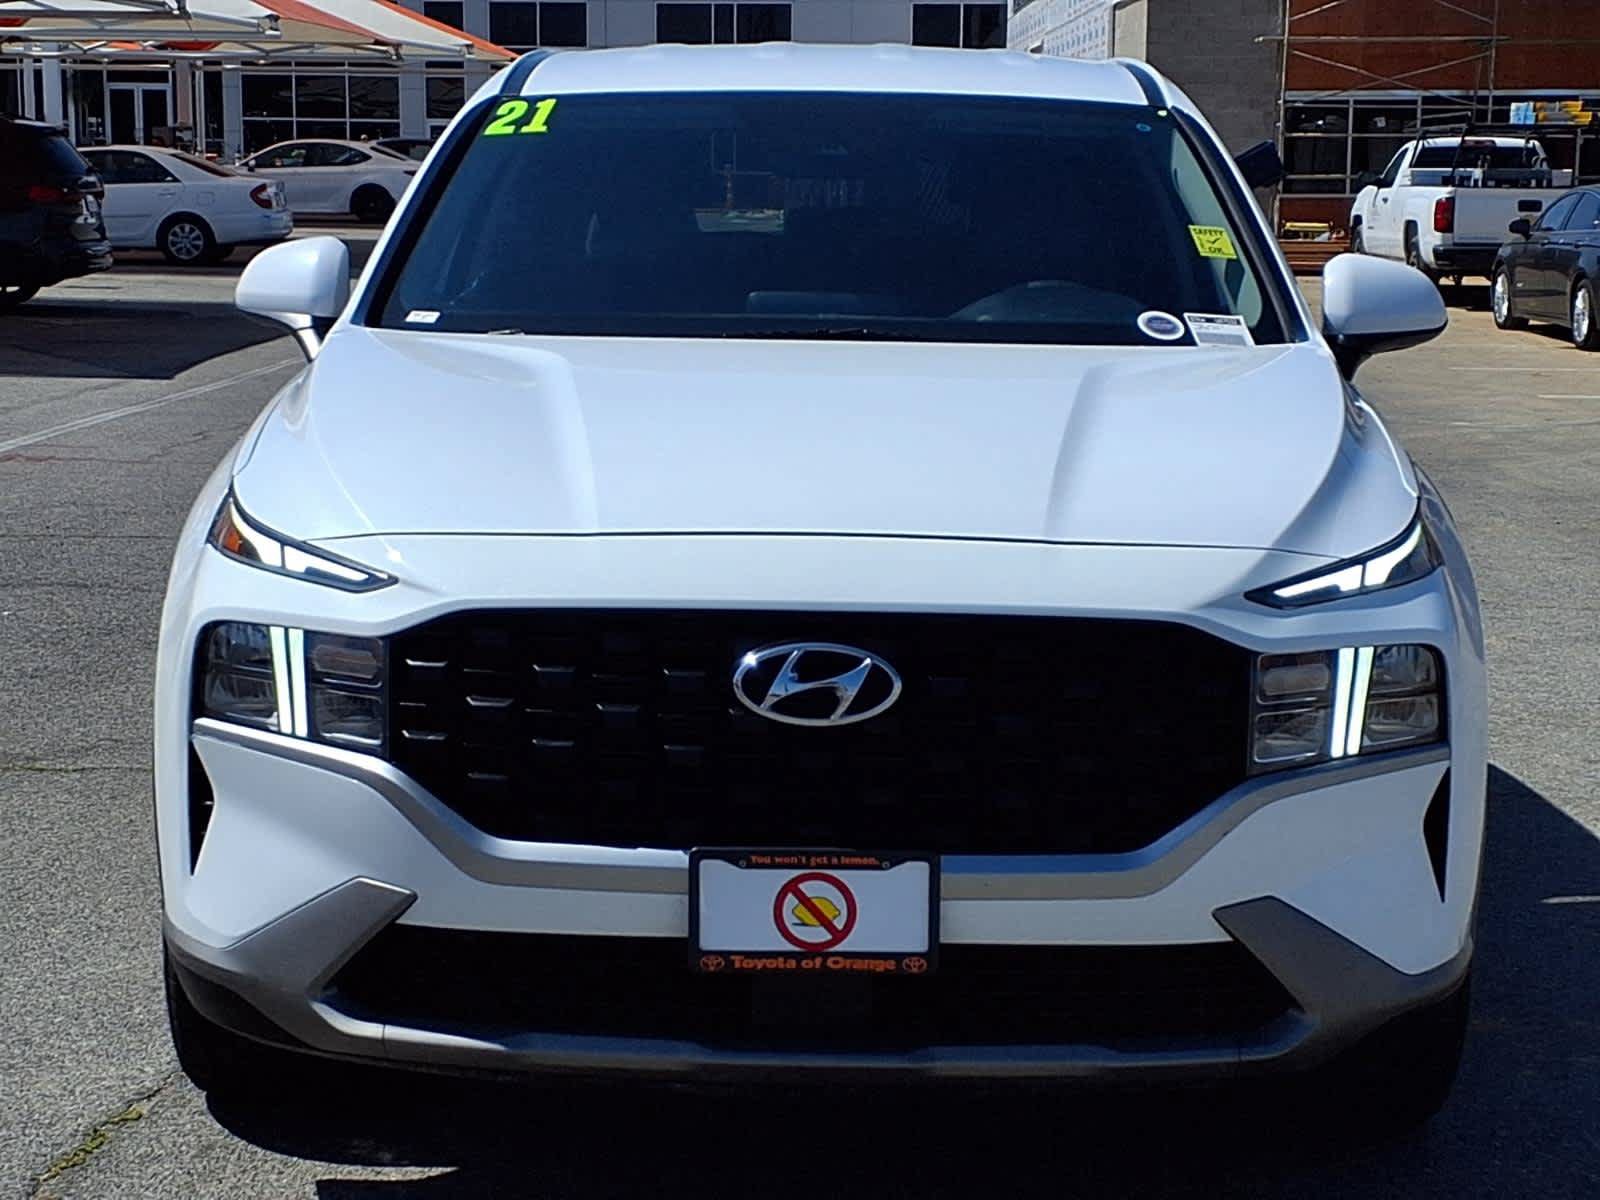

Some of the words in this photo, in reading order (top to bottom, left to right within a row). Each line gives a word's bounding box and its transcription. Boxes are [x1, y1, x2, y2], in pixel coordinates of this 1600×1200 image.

[483, 98, 557, 135] 21
[751, 855, 771, 865] You
[775, 855, 806, 865] won't
[809, 855, 828, 867] get
[831, 856, 838, 865] a
[841, 855, 880, 865] lemon.
[730, 955, 797, 970] Toyota
[801, 956, 821, 969] of
[826, 956, 897, 973] Orange
